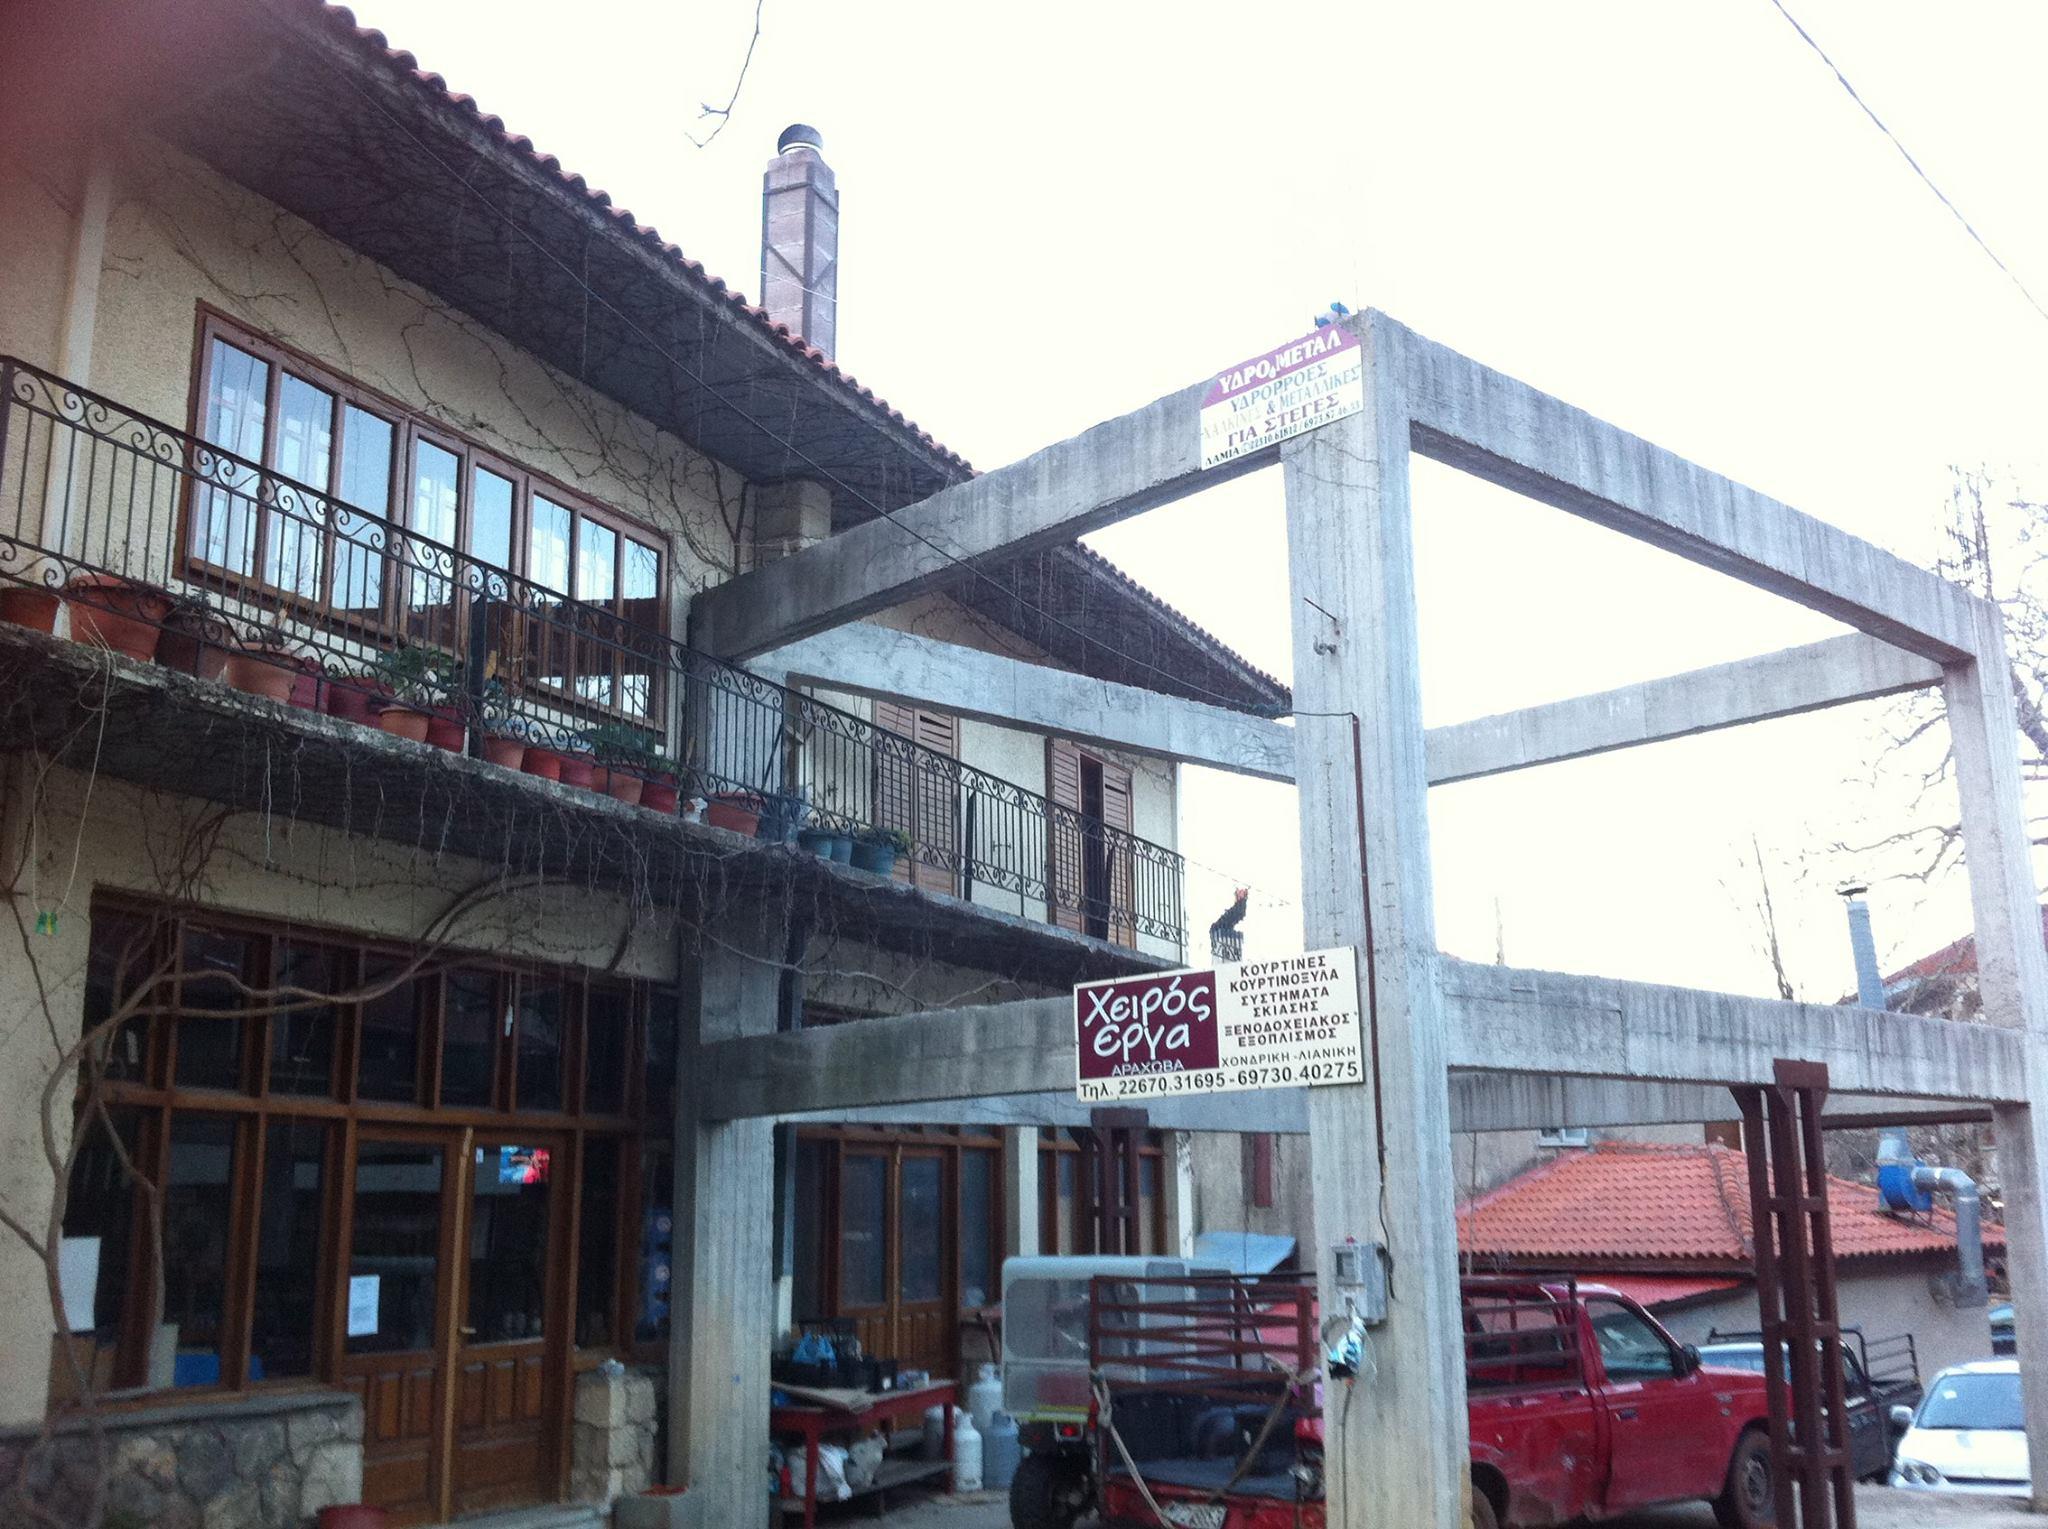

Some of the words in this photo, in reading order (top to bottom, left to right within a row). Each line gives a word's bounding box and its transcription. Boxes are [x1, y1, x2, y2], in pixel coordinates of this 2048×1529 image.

[1230, 362, 1328, 413] ΥΔΡΟΡΡΟΕΣ
[1266, 399, 1276, 416] &
[1228, 425, 1258, 448] ΓΙΑ
[1264, 391, 1340, 434] ΣΤΕΓΕΣ
[1205, 446, 1240, 467] ΛΑΜΙΑ
[1240, 955, 1327, 977] ΚΟΥΡΤΙΝΕΣ
[1230, 968, 1340, 993] ΚΟΥΡΤΙΝΟΞΥΛΑ
[1083, 976, 1211, 1027] Χειρός
[1241, 986, 1331, 1007] ΣΥΣΤΗΜΑΤΑ
[1253, 1000, 1319, 1018] ΣΚΙΑΣΗΣ
[1225, 1013, 1350, 1037] ΞΕΝΟΔΟΧΕΙΑΚΟΣ
[1238, 1027, 1337, 1048] ΕΞΟΠΛΙΣΜΟΣ
[1111, 1058, 1186, 1077] ΑΡΑΧΩΒΑ
[1222, 1051, 1290, 1067] ΧΟΝΔΡΙΚΗ
[1080, 1082, 1114, 1100] Τηλ.
